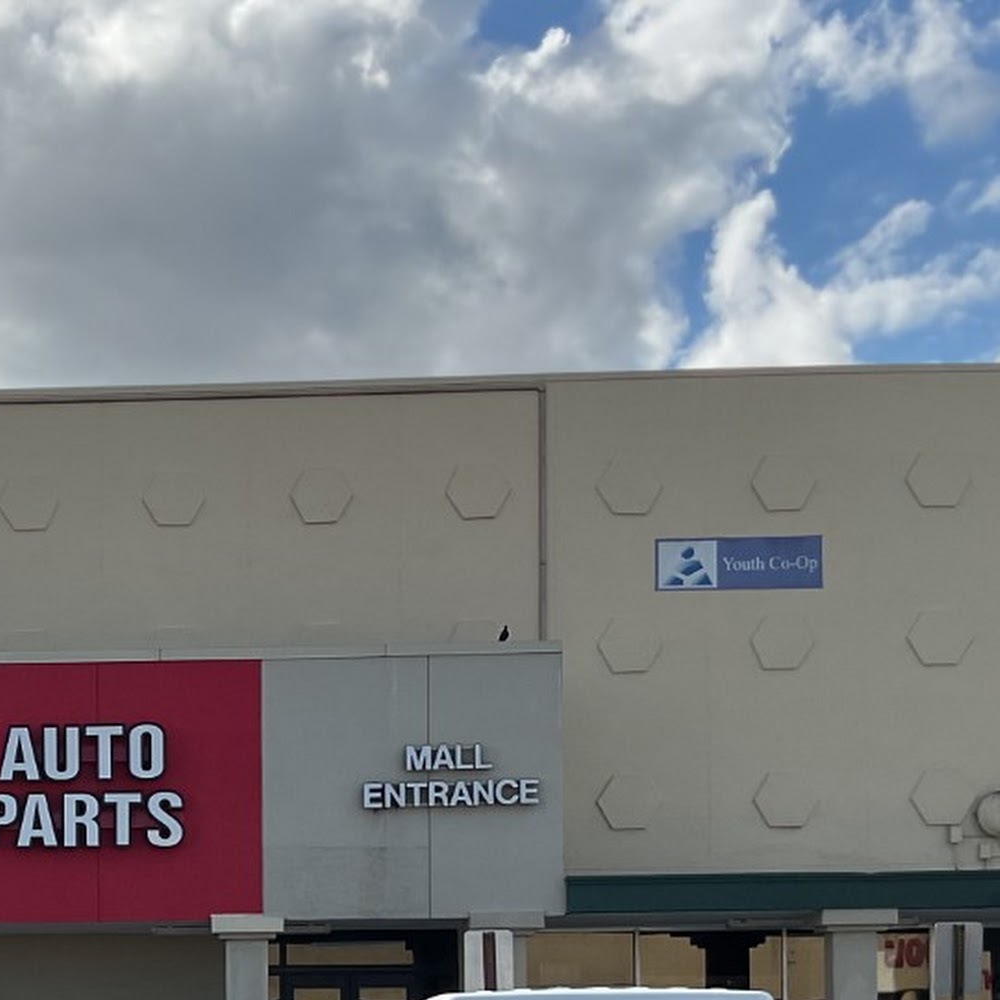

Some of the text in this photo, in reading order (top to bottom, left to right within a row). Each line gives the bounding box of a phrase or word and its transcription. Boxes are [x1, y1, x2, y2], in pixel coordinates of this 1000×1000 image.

[722, 555, 818, 573] Youth Co-Op
[405, 743, 494, 772] MALL
[363, 778, 540, 810] ENTRANCE
